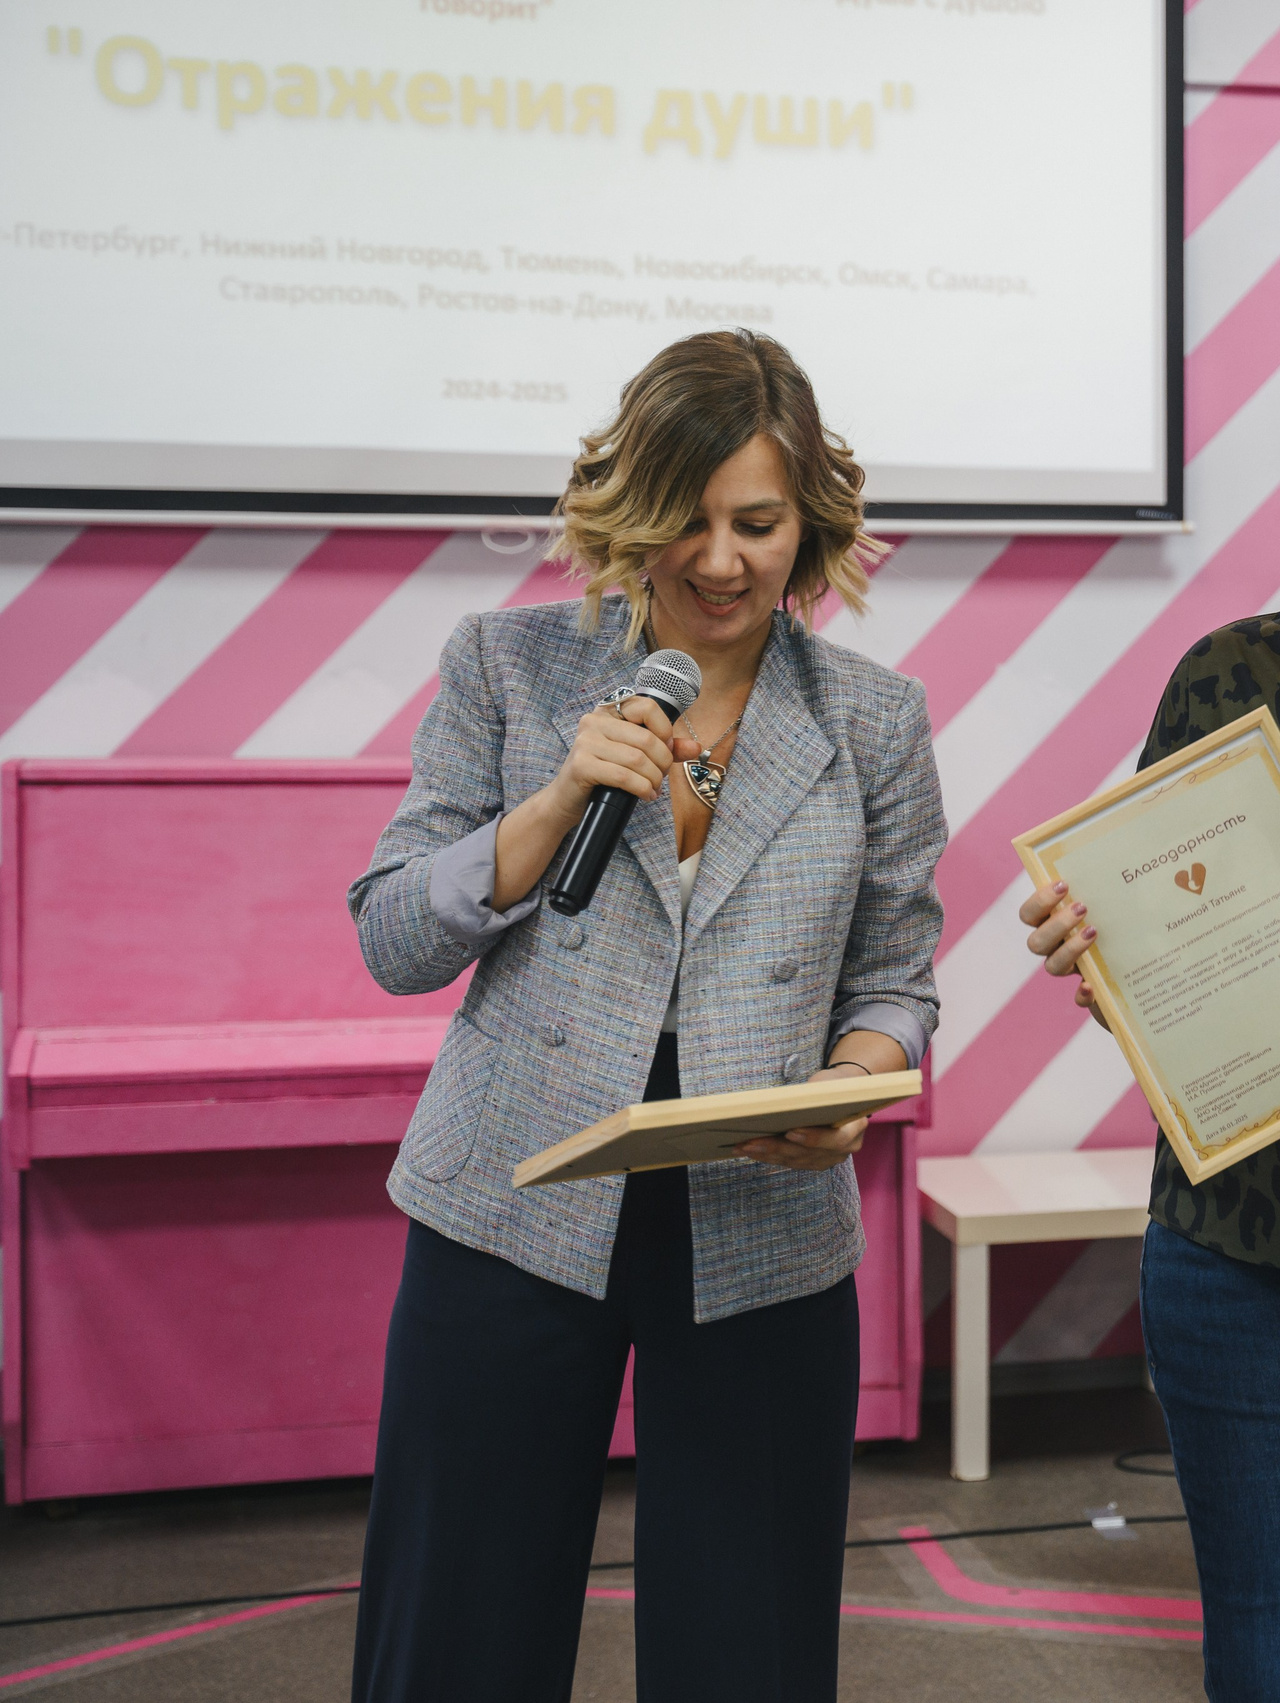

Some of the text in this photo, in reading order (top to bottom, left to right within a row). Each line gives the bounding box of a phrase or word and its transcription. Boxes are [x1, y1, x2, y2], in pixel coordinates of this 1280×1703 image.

[46, 25, 915, 160] "Отражения души"
[199, 230, 328, 262] Нижний
[336, 238, 490, 276] Новгород,
[500, 245, 626, 280] Тюмень,
[632, 253, 832, 294] Новосибирск,
[838, 263, 919, 296] Омск,
[218, 274, 774, 326] Ставрополь, Ростов-на-Дону, Москва
[441, 378, 570, 403] 2024-2025
[1121, 814, 1246, 884] Благодарность
[1164, 885, 1247, 932] Хаминой Татьяне
